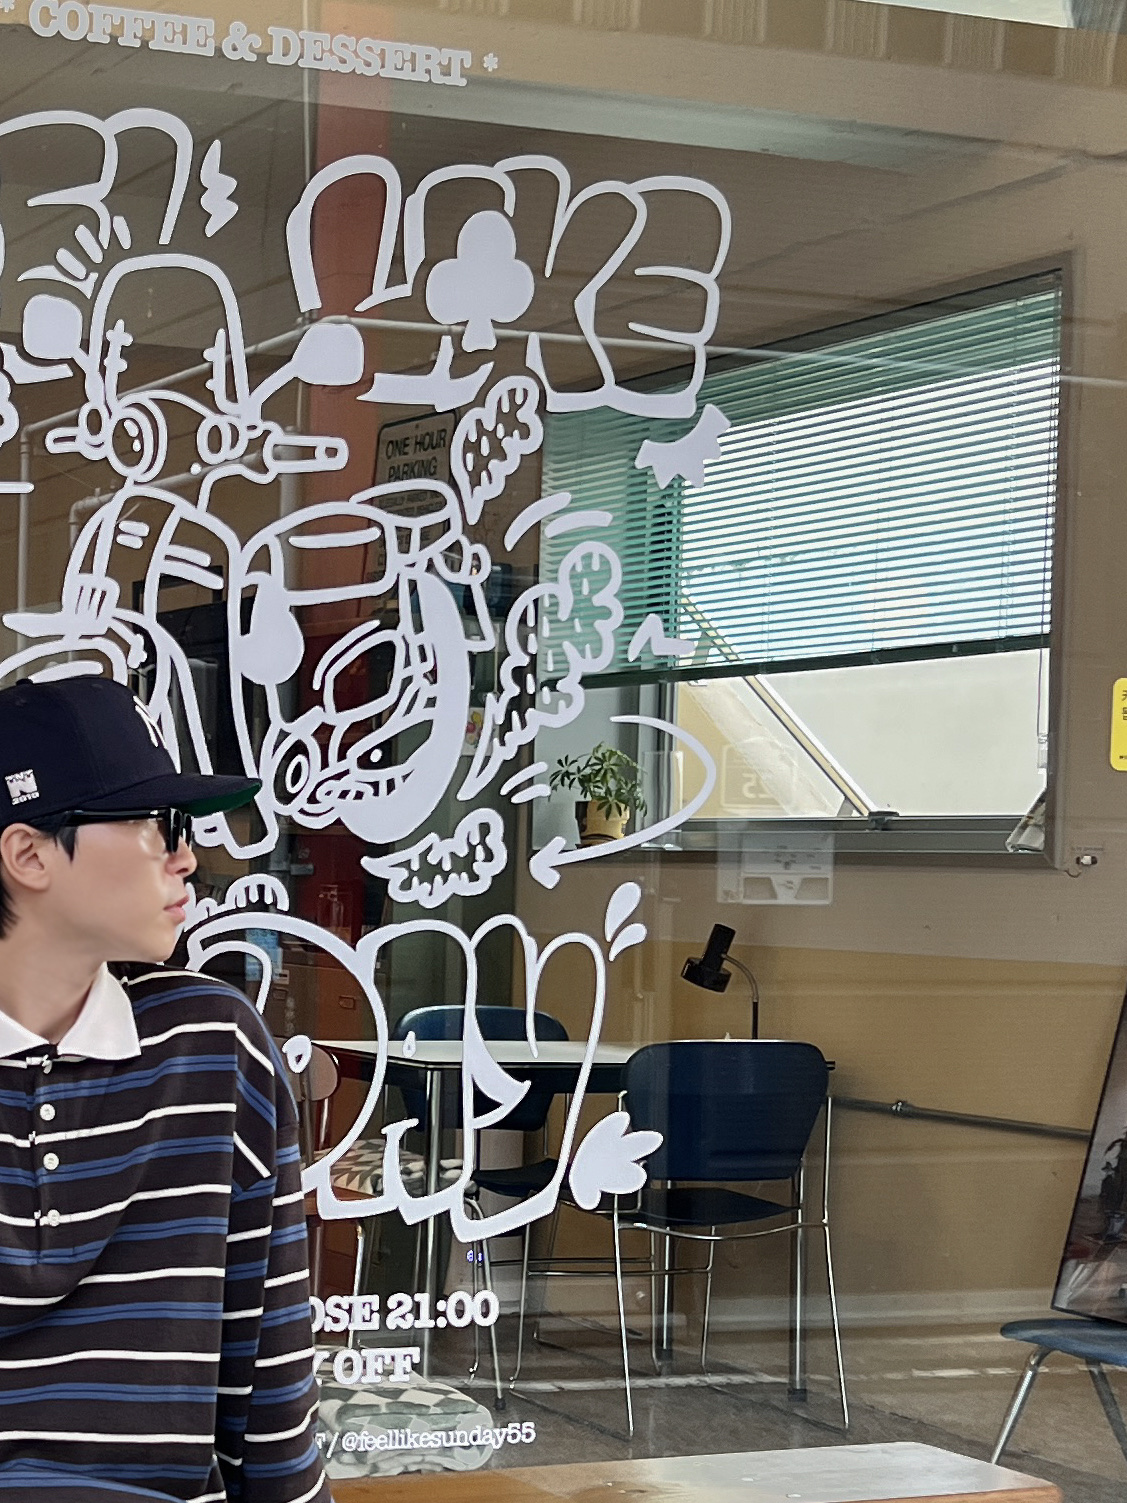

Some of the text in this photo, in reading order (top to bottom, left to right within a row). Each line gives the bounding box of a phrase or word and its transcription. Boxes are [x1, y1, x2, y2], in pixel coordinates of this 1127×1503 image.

[28, 0, 472, 87] COFFEE & DESSERT
[386, 428, 448, 460] ONE HOUR
[388, 457, 438, 482] PARKING
[309, 1289, 500, 1333] OSE 21:00
[333, 1346, 421, 1385] OFF
[341, 1421, 537, 1452] @feellikesunday55
